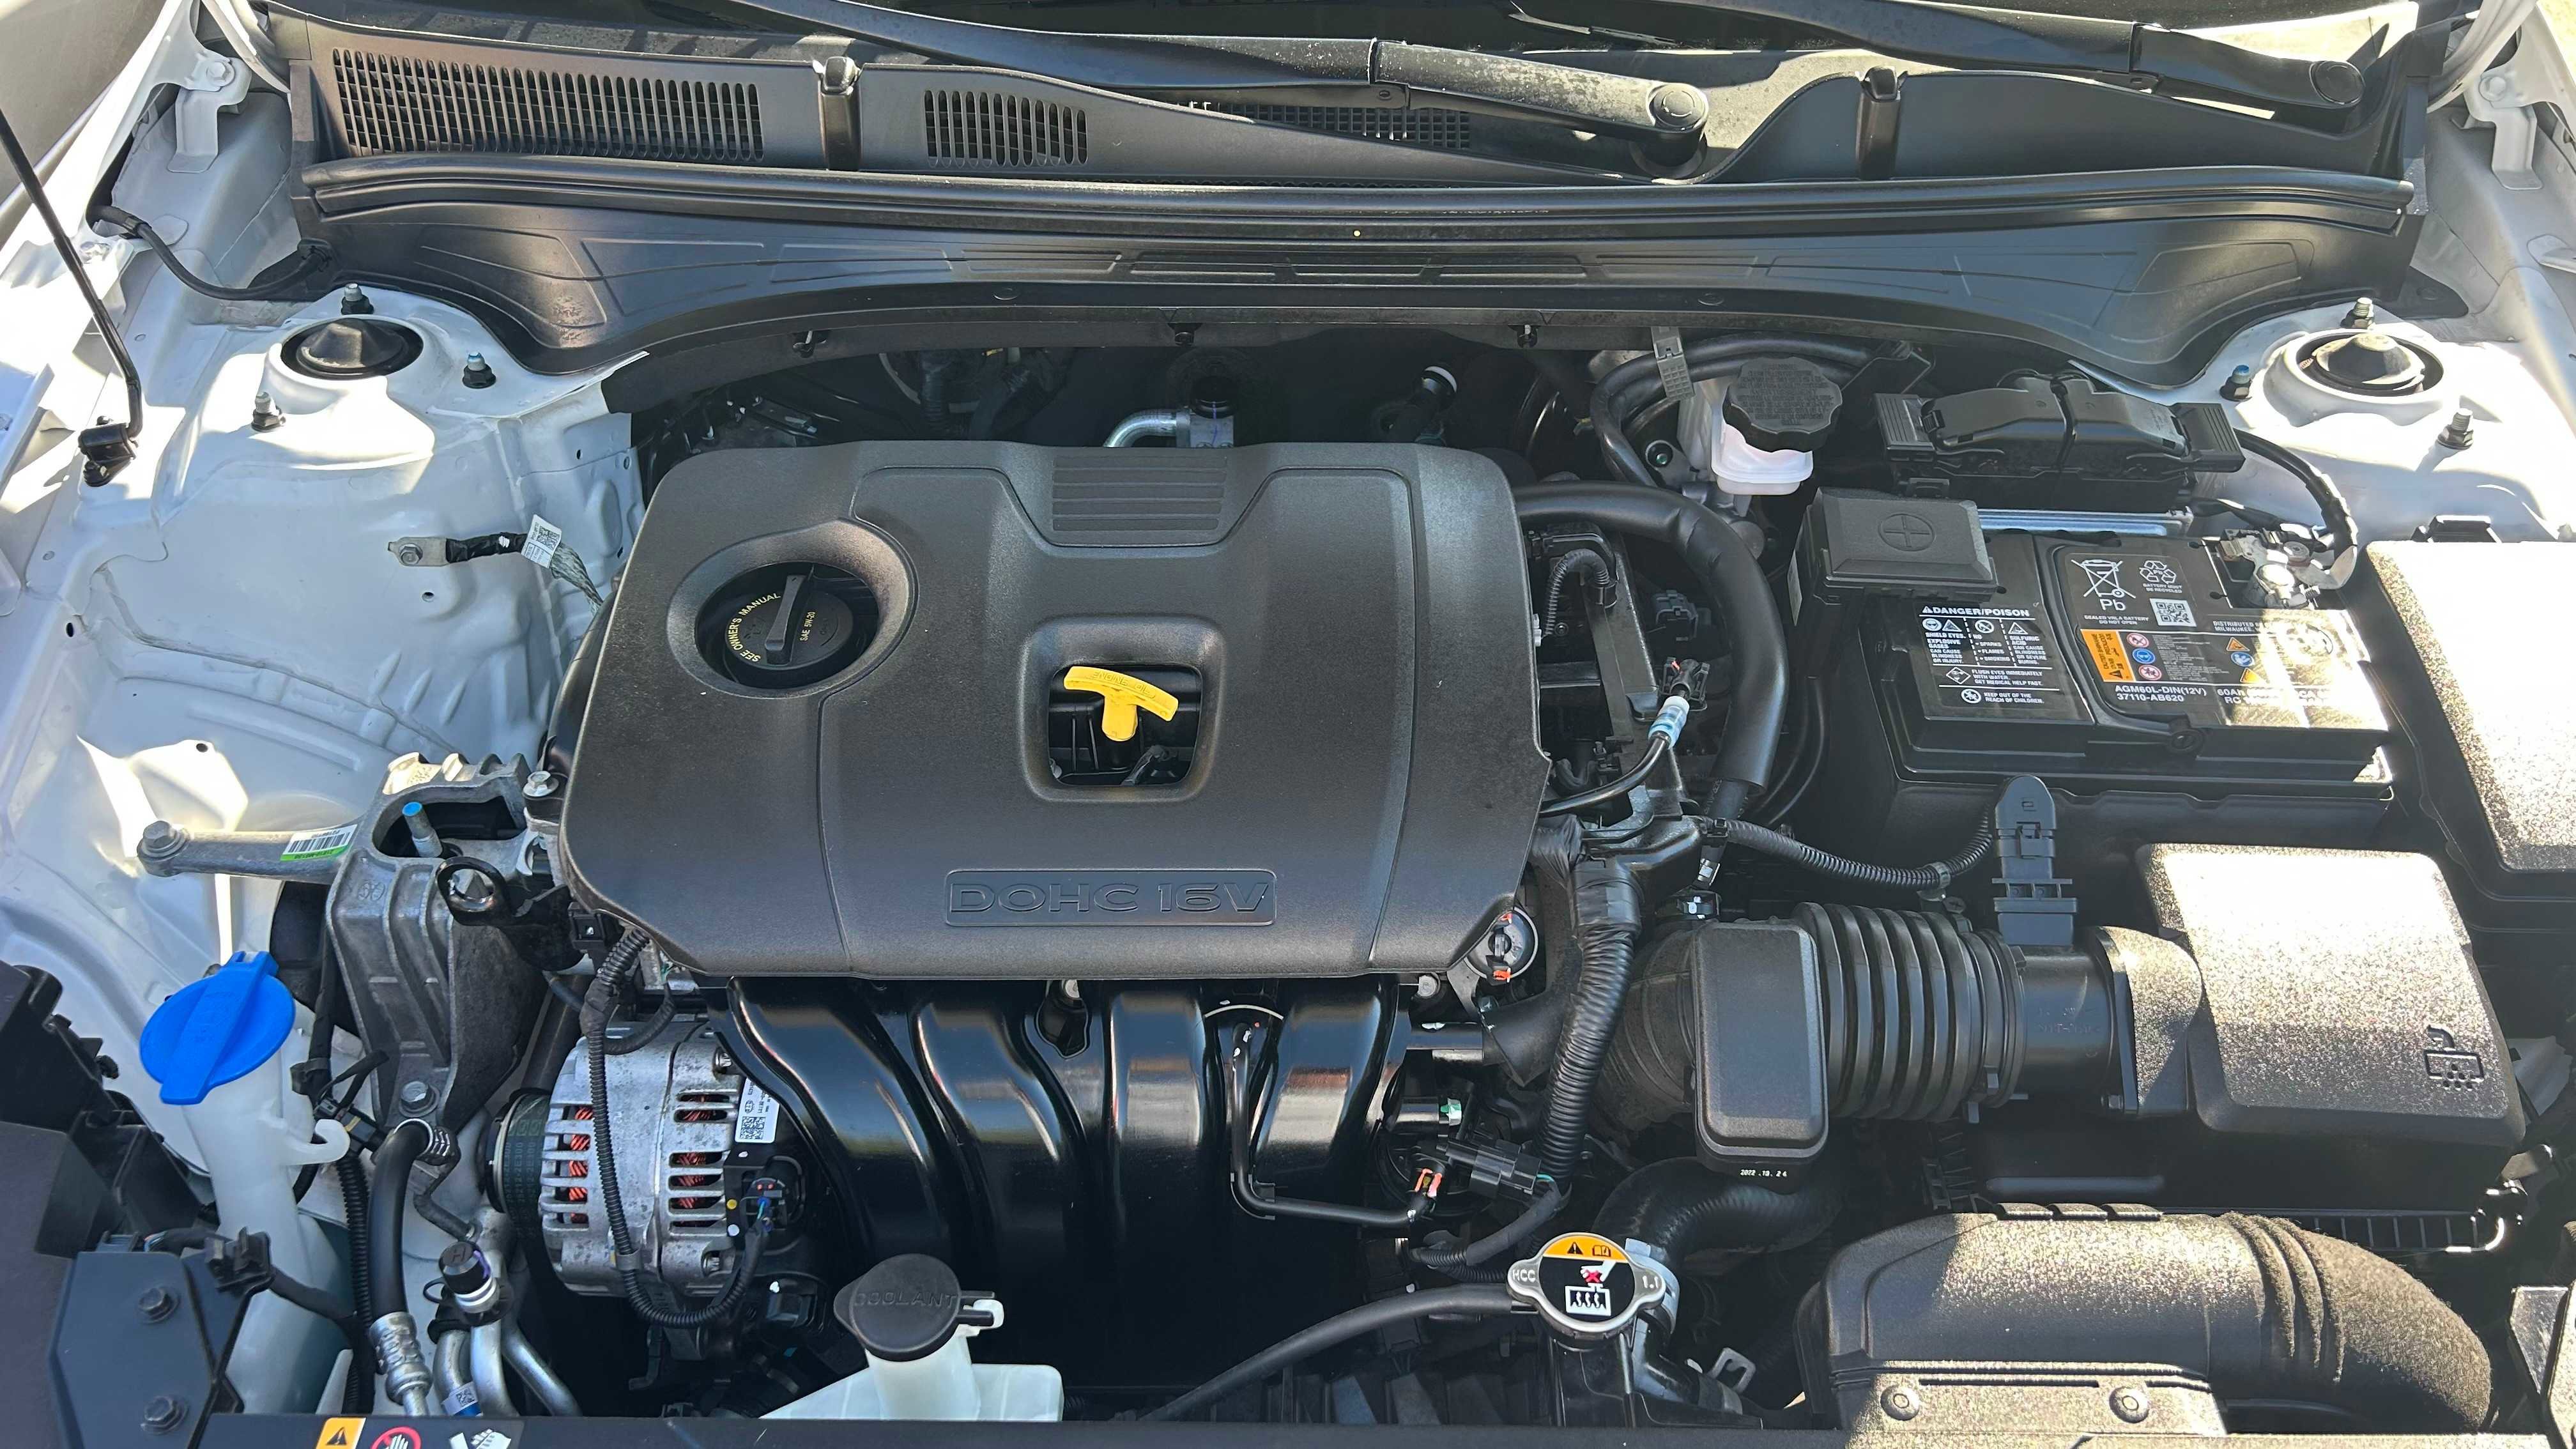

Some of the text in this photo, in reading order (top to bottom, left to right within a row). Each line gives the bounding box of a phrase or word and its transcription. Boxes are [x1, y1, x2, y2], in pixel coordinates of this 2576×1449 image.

[2099, 598, 2126, 611] Pb
[1932, 607, 2030, 617] DANGER/POISON
[727, 593, 781, 662] SEE OWNER'S MANUAL
[799, 629, 811, 641] SAE
[1092, 670, 1130, 686] ENGINE
[2115, 685, 2207, 696] AGM60L-DIN(12V)
[2117, 694, 2184, 703] 37110-AB620
[2224, 697, 2242, 705] RC
[949, 882, 1269, 913] DOHC 16V
[1512, 1269, 1659, 1289] HCC 1.1
[854, 1291, 958, 1310] COOLANT
